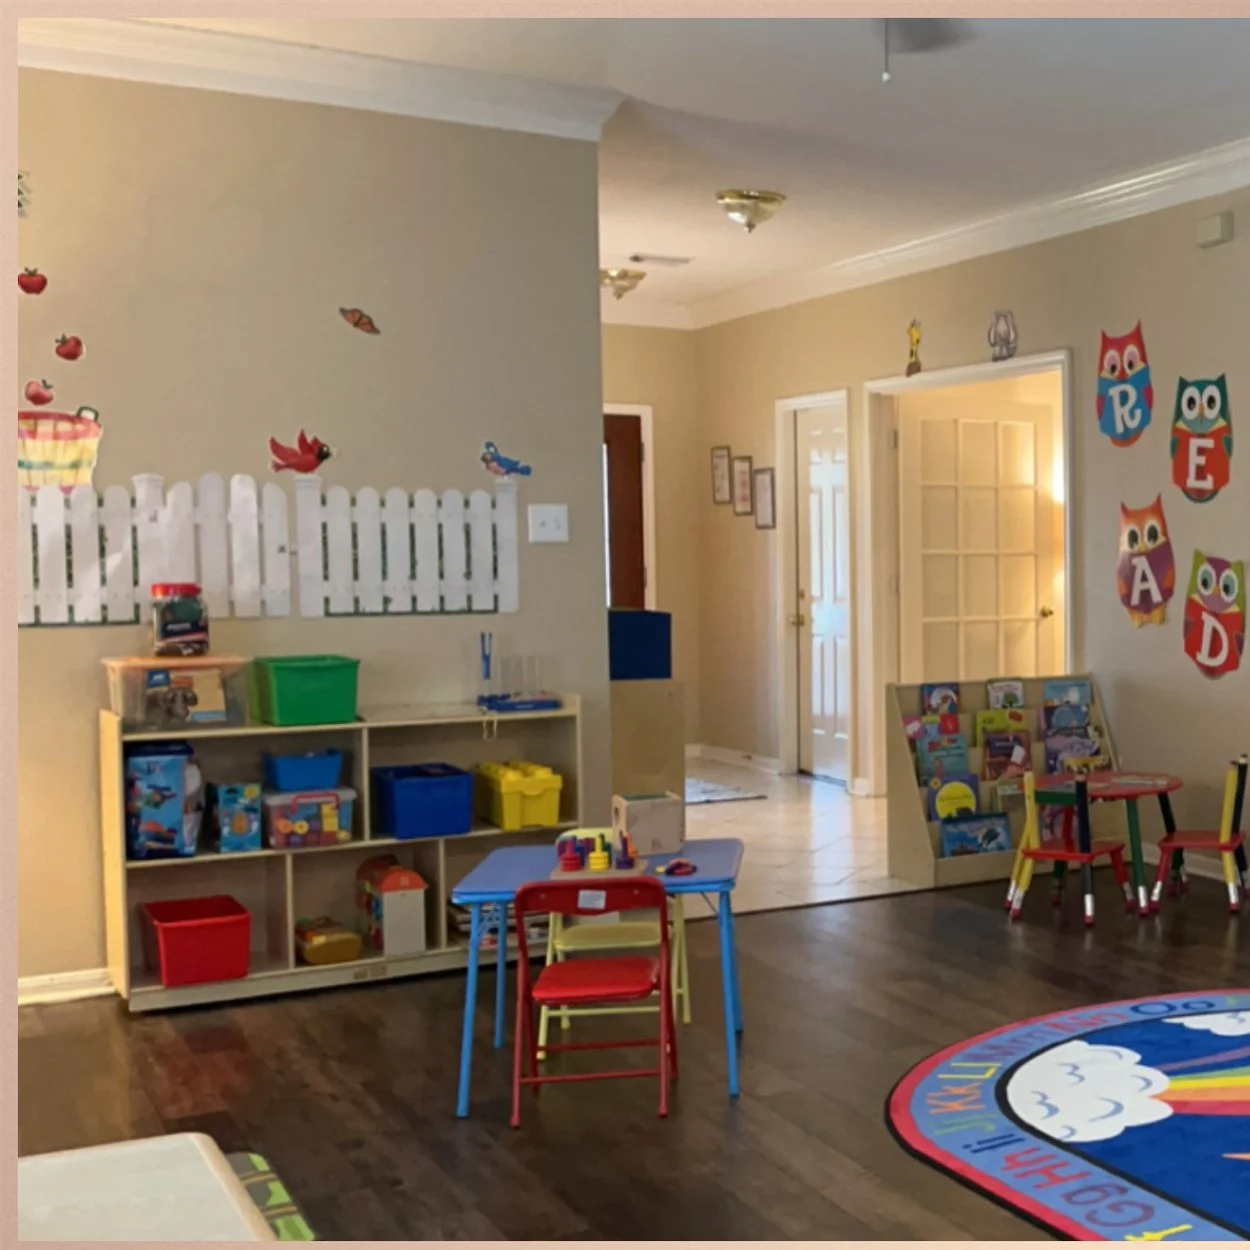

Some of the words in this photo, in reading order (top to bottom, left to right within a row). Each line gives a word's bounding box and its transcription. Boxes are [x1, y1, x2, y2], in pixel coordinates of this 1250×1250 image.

[1108, 383, 1142, 434] R
[1186, 438, 1214, 489] E
[1130, 556, 1162, 606] A
[1196, 611, 1229, 667] D
[1131, 1000, 1216, 1015] Oo
